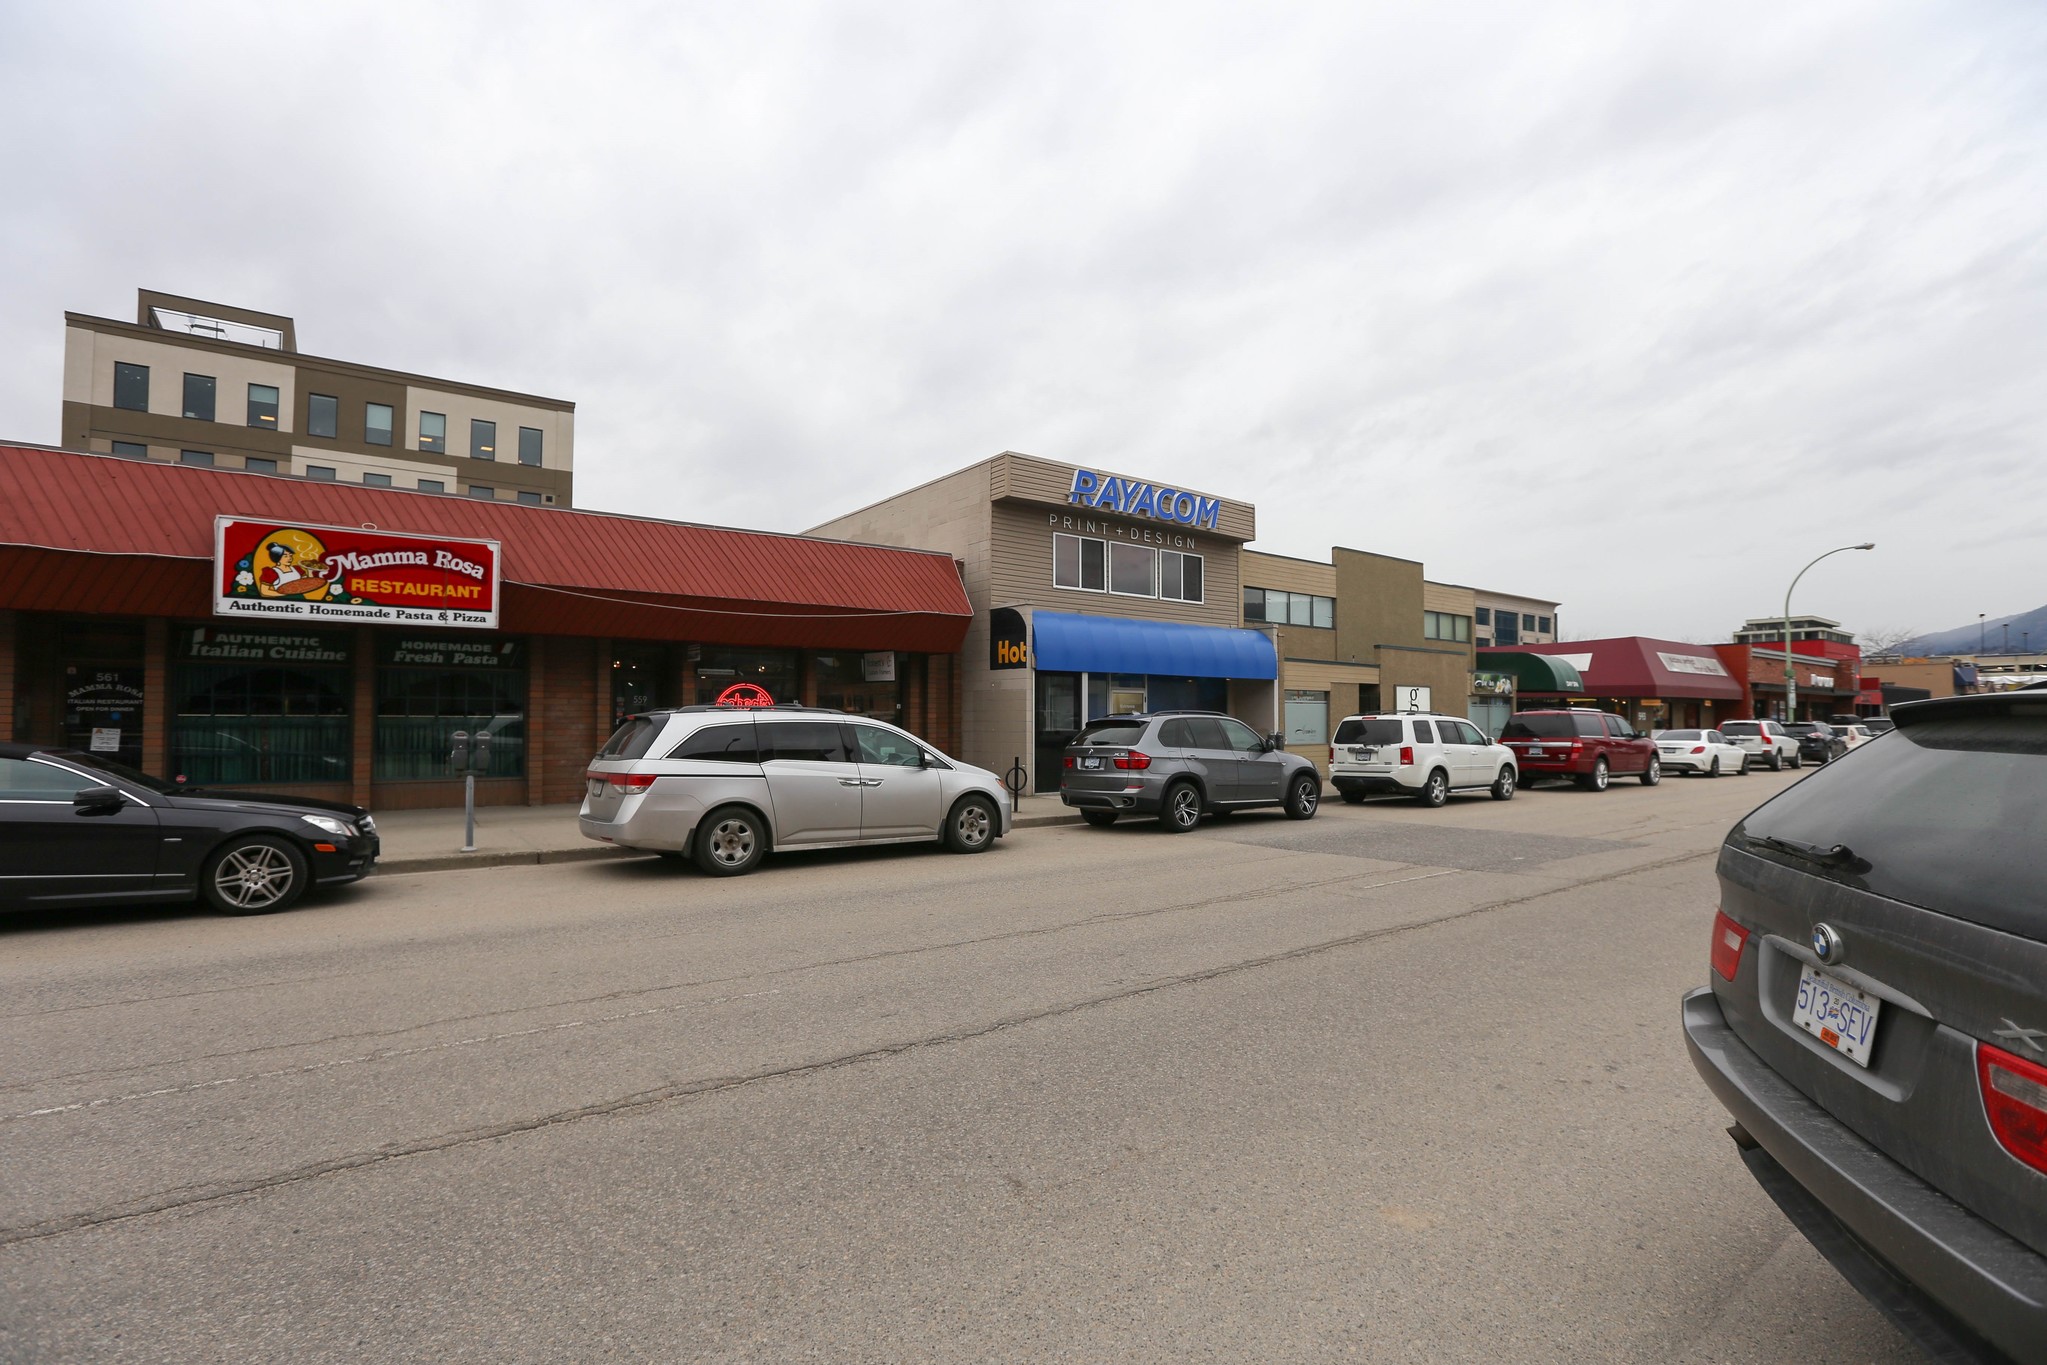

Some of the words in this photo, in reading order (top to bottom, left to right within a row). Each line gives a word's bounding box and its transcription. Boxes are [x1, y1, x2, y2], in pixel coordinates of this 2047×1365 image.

[1067, 469, 1222, 530] RAYACOM
[1049, 514, 1109, 535] PRINT
[1131, 528, 1195, 549] DESIGN
[325, 551, 429, 582] Mamma
[433, 550, 484, 579] Rosa
[351, 578, 481, 598] RESTAURANT
[229, 600, 303, 614] Authentic
[309, 605, 391, 618] Homemade
[396, 610, 433, 621] Pasta
[438, 611, 448, 621] &
[453, 612, 487, 623] Pizza
[216, 634, 320, 646] AUTHENTIC
[401, 641, 492, 652] HOMEMADE
[190, 644, 264, 658] Italian
[269, 646, 347, 661] Cuisine
[393, 651, 444, 663] Fresh
[452, 653, 498, 665] Pasta
[998, 640, 1027, 664] Hot
[96, 673, 119, 682] 561
[68, 683, 113, 698] MAMMA
[115, 684, 144, 698] ROSA
[633, 695, 648, 704] 559
[1798, 979, 1830, 1020] 513
[1837, 1002, 1874, 1046] SEV
